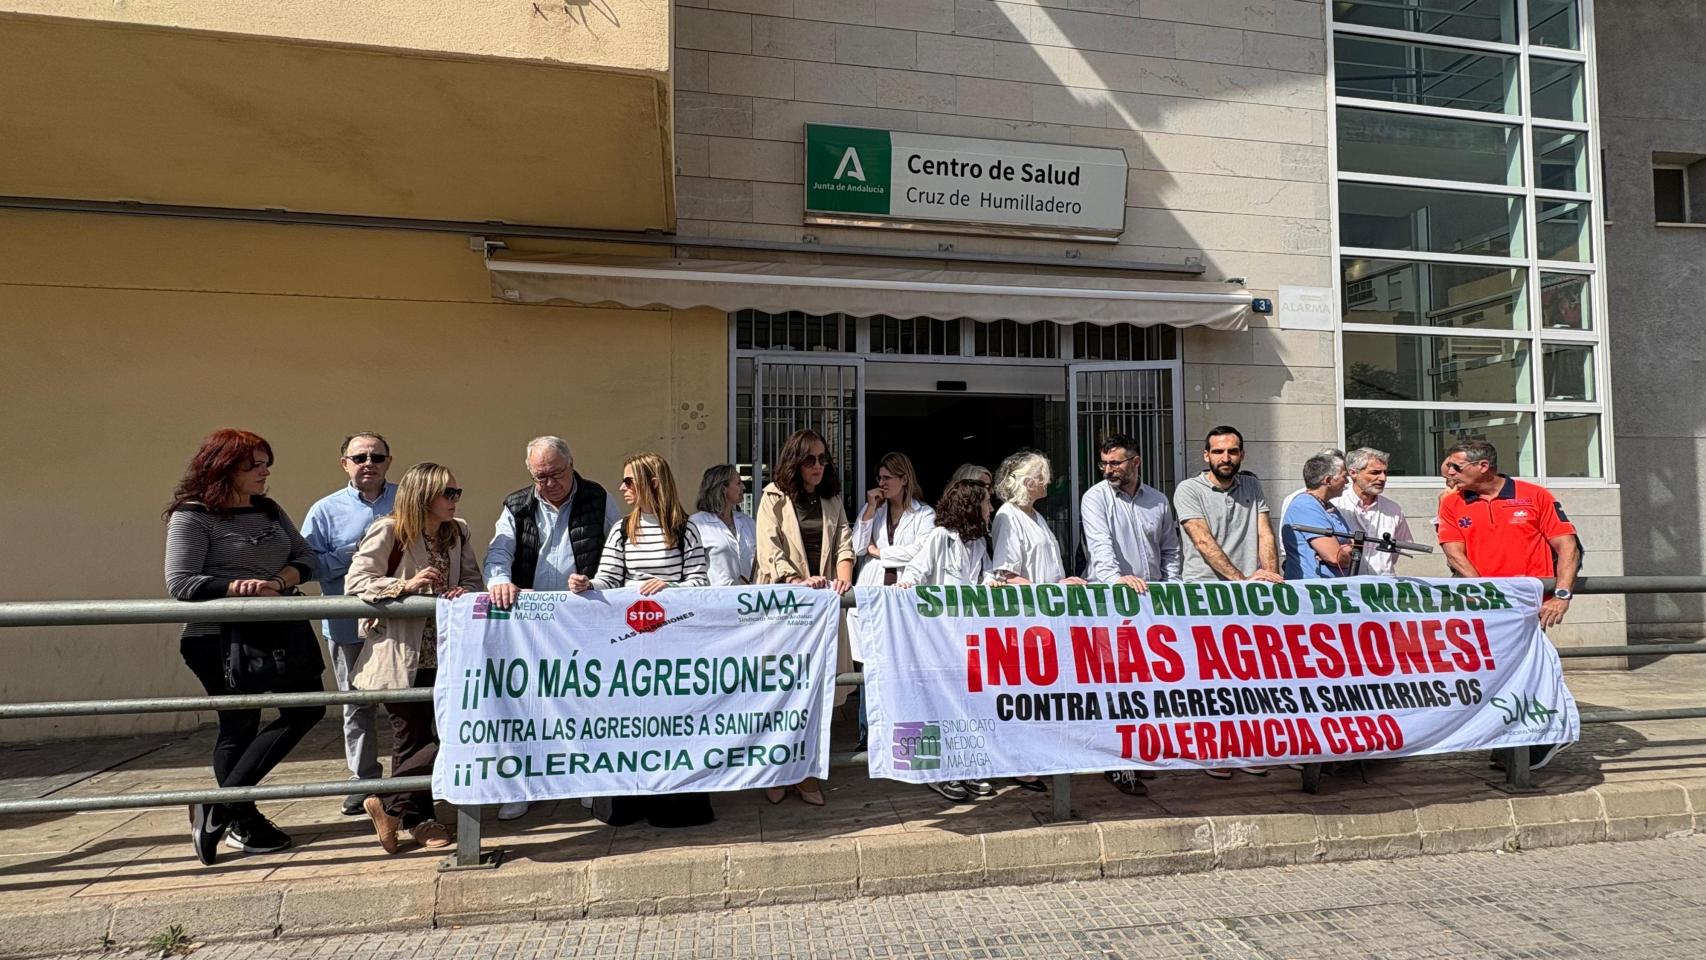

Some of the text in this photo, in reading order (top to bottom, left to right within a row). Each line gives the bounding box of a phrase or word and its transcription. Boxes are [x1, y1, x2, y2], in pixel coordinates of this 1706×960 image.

[907, 154, 1080, 186] Centro de Salud
[812, 182, 834, 191] Junta
[847, 183, 884, 193] Andalucía
[906, 187, 1081, 214] Cruz de Humilladero
[1259, 300, 1266, 310] 3
[1281, 303, 1330, 313] ALARMA
[515, 601, 555, 611] MÉDICO
[516, 592, 567, 603] SINDICATO
[737, 589, 814, 616] SMA
[916, 584, 1140, 618] SINDICATO
[1305, 584, 1360, 615] DE
[618, 631, 637, 641] LAS
[639, 611, 695, 634] AGRESIONES
[629, 611, 663, 621] STOP
[966, 618, 1496, 693] ¡NO MÁS AGRESIONES!
[461, 650, 811, 709] ¡¡NO MÁS AGRESIONES!!
[997, 678, 1482, 721] CONTRA LAS AGRESIONES A SANITARIAS-OS
[1490, 690, 1559, 727] SMA
[459, 708, 809, 744] CONTRA LAS AGRESIONES A SANITARIOS
[942, 718, 996, 734] SINDICATO
[1116, 714, 1404, 762] TOLERANCIA CERO
[945, 733, 985, 749] MÉDICO
[454, 741, 806, 786] ¡¡TOLERANCIA CERO!!
[947, 750, 992, 768] MÁLAGA
